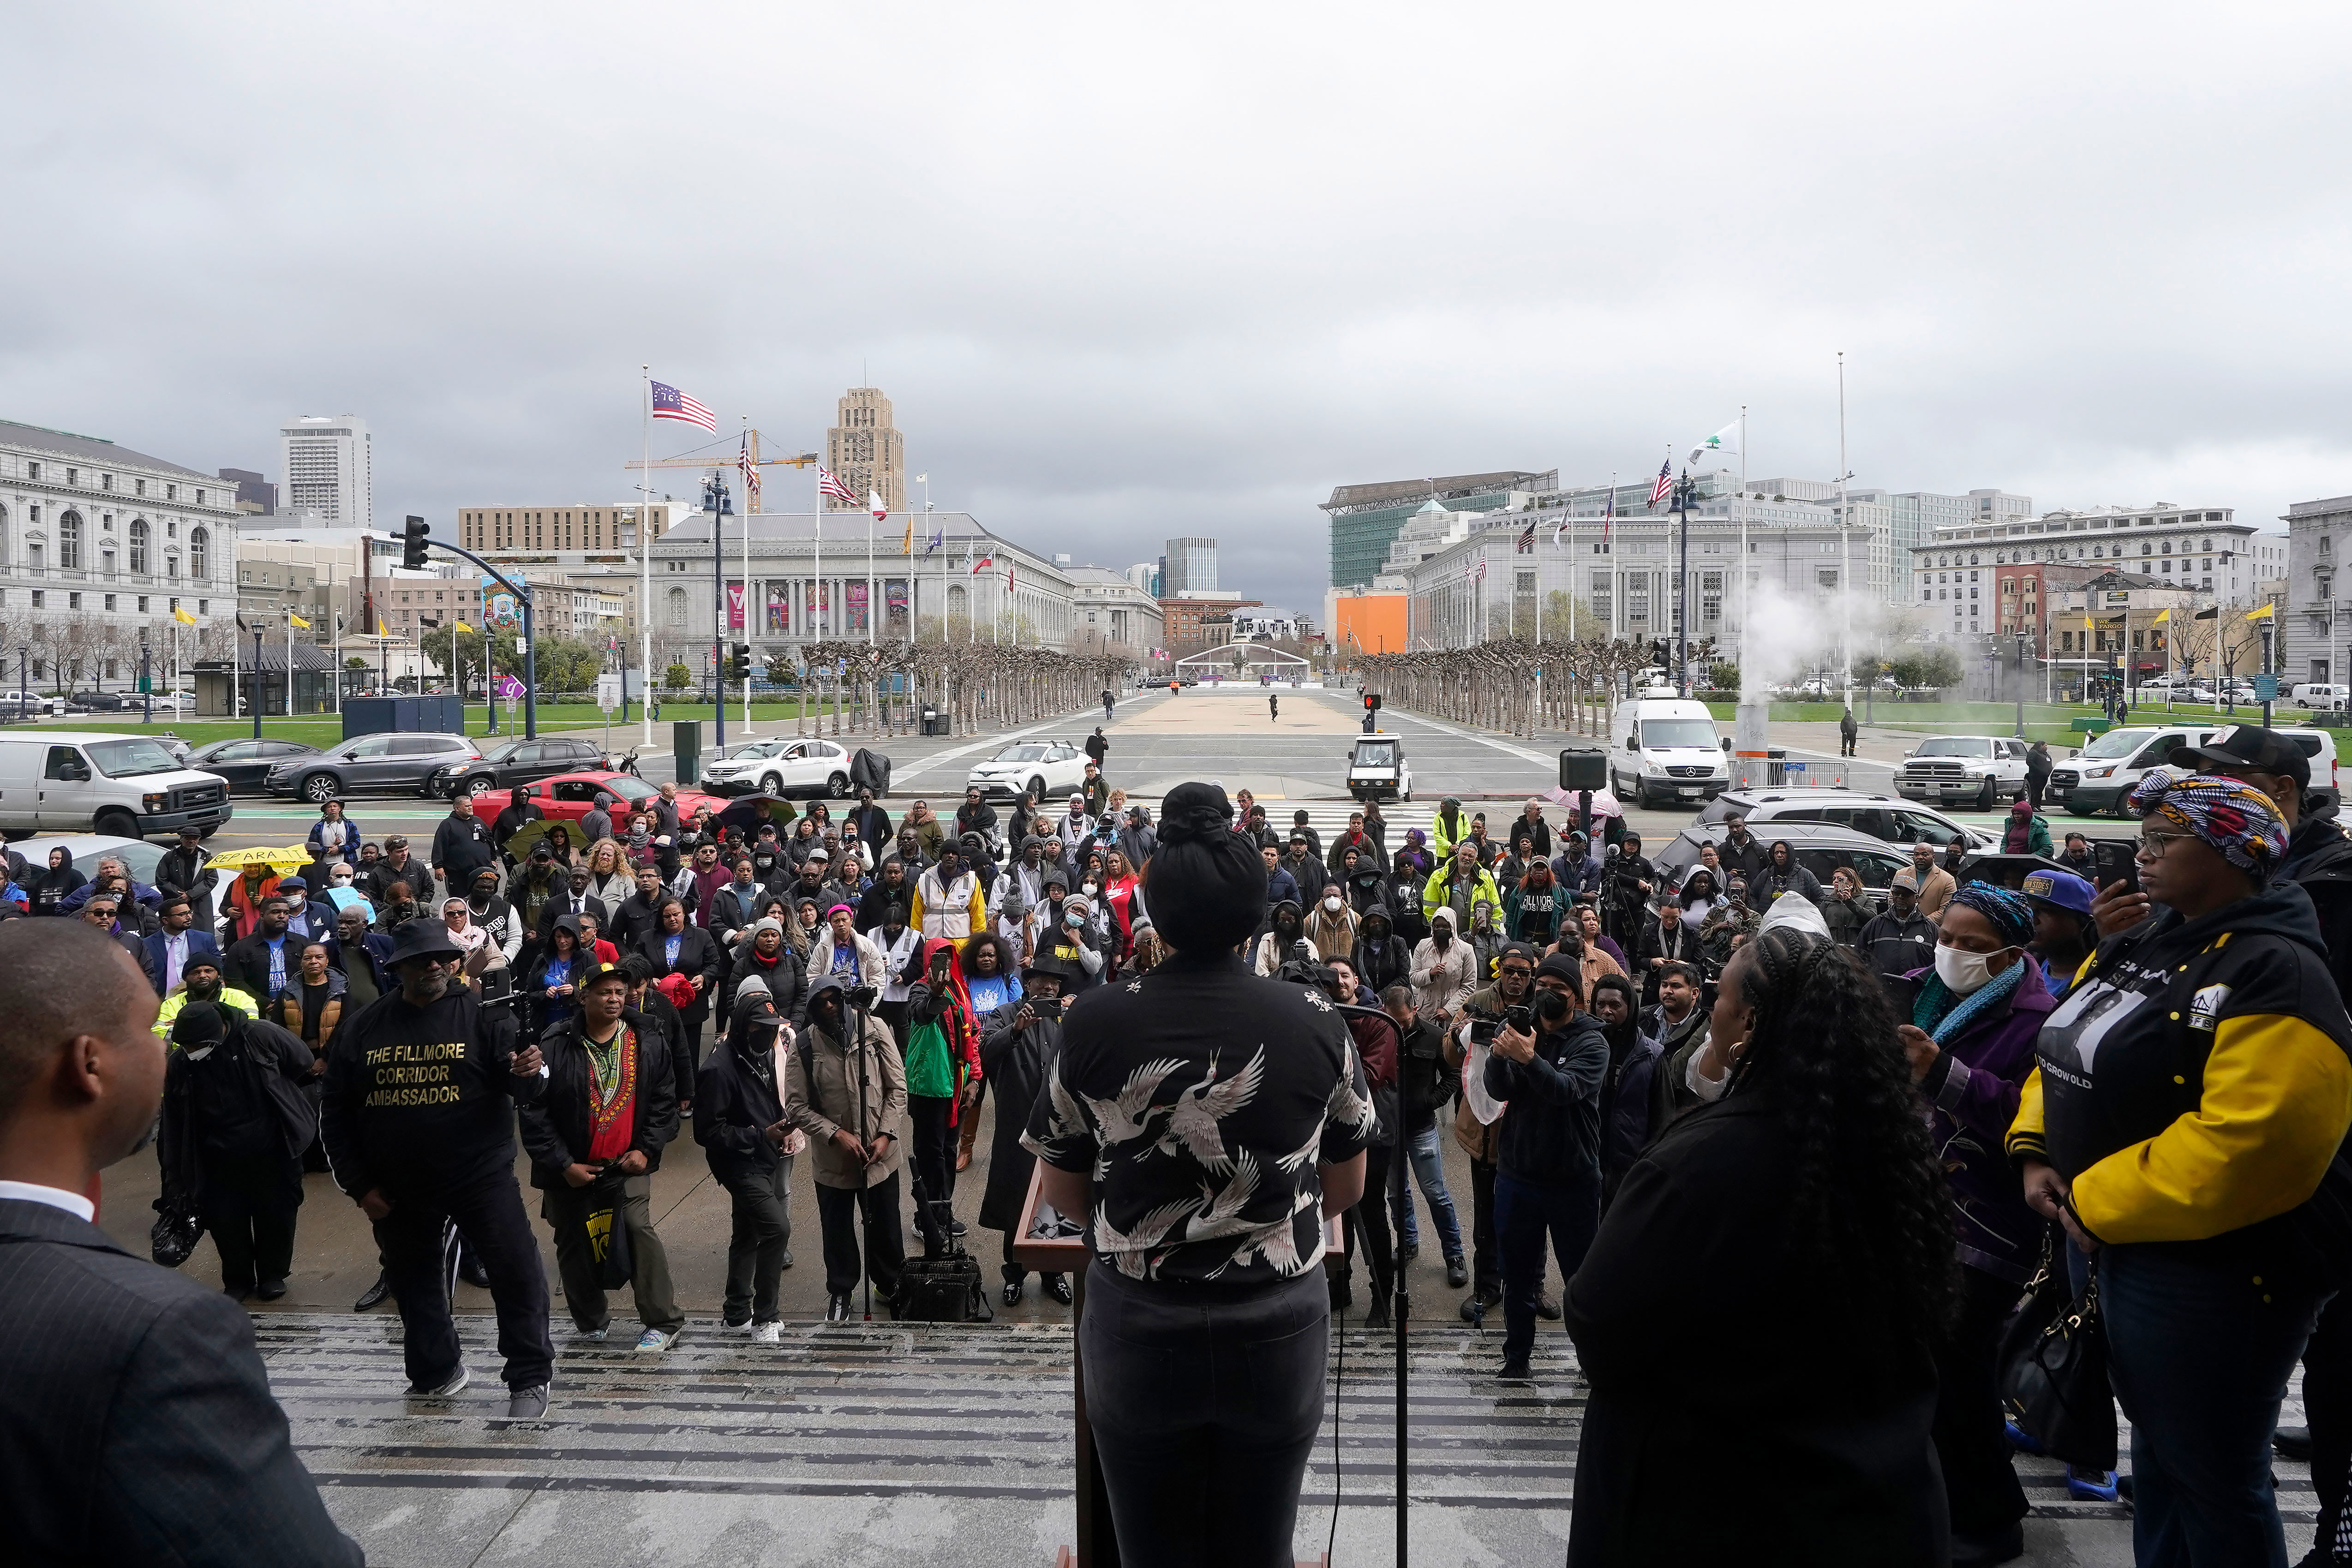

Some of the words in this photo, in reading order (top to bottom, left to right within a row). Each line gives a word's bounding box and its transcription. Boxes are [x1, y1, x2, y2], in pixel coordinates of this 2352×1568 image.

[661, 392, 674, 402] 76
[719, 625, 726, 634] 20
[1246, 623, 1289, 633] RUTH
[2032, 882, 2047, 890] SIDES
[480, 916, 506, 933] cago
[497, 930, 507, 940] 23
[269, 971, 287, 981] REAM
[366, 1046, 391, 1066] THE
[394, 1043, 465, 1061] FILLMORE
[376, 1065, 449, 1085] CORRIDOR
[2047, 1062, 2071, 1082] GROW
[2070, 1075, 2093, 1089] OLD
[365, 1085, 460, 1107] AMBASSADOR
